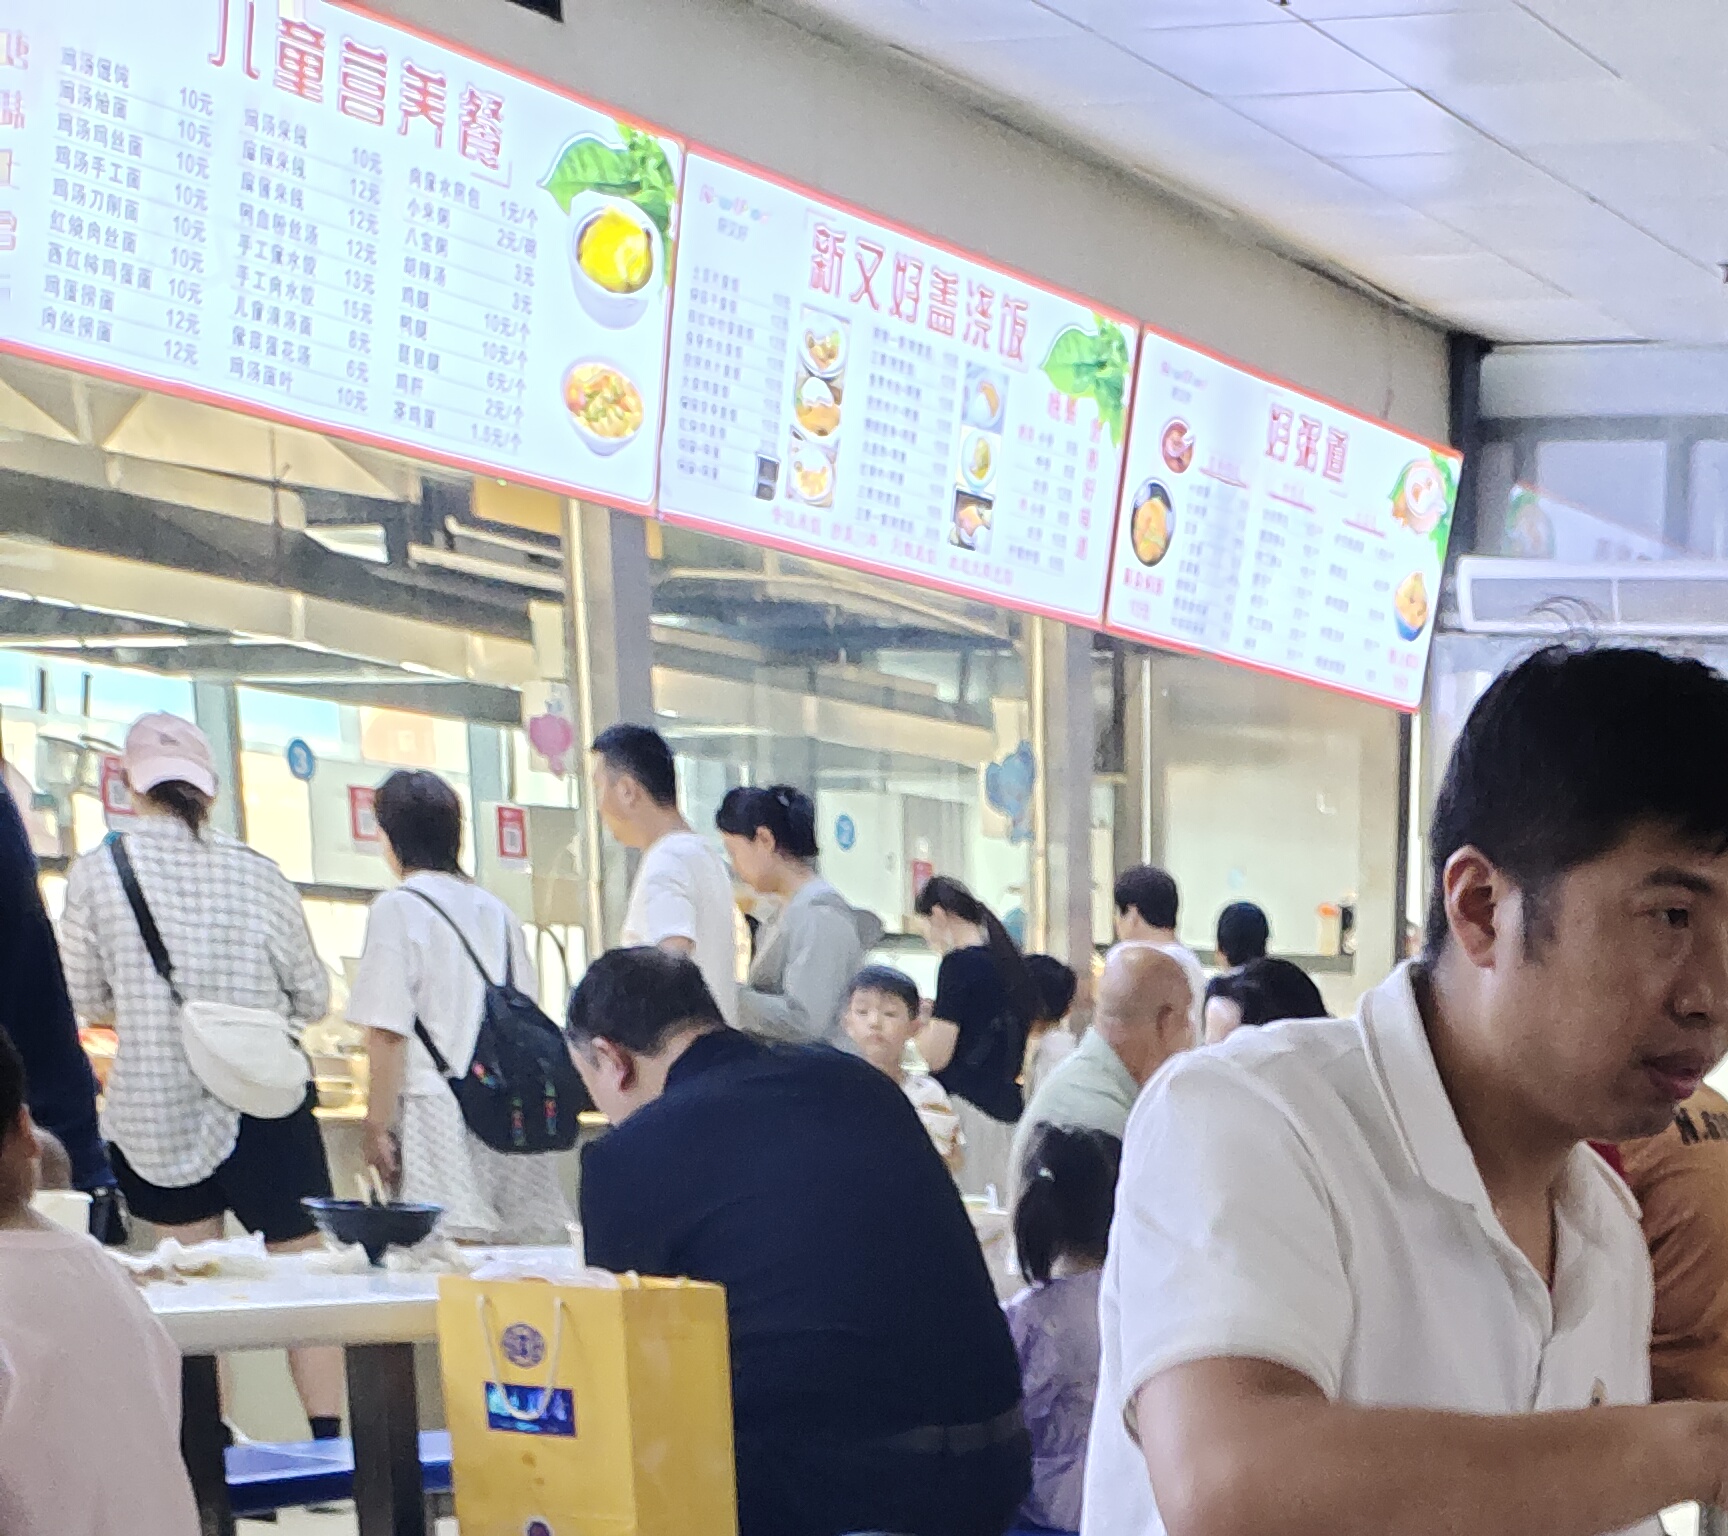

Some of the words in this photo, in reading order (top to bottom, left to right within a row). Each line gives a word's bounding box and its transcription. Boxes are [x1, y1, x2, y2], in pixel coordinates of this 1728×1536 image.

[209, 0, 504, 170] 儿童营养餐
[180, 87, 213, 115] 10元
[178, 120, 211, 147] 10元
[177, 152, 210, 179] 10元
[352, 148, 382, 175] 10元
[56, 146, 140, 190] 鸡汤手工面
[175, 183, 208, 211] 10元
[351, 178, 380, 205] 12元
[53, 178, 139, 223] 鸡汤刀削面
[173, 215, 206, 243] 10元
[349, 209, 379, 235] 12元
[500, 200, 538, 230] 1元/个
[347, 239, 377, 265] 12元
[405, 227, 448, 258] 八宝粥
[171, 247, 204, 273] 10元
[169, 278, 202, 305] 10元
[810, 223, 1029, 361] 新又好盖浇饭
[166, 308, 200, 335] 12元
[164, 339, 198, 365] 12元
[338, 386, 367, 411] 10元
